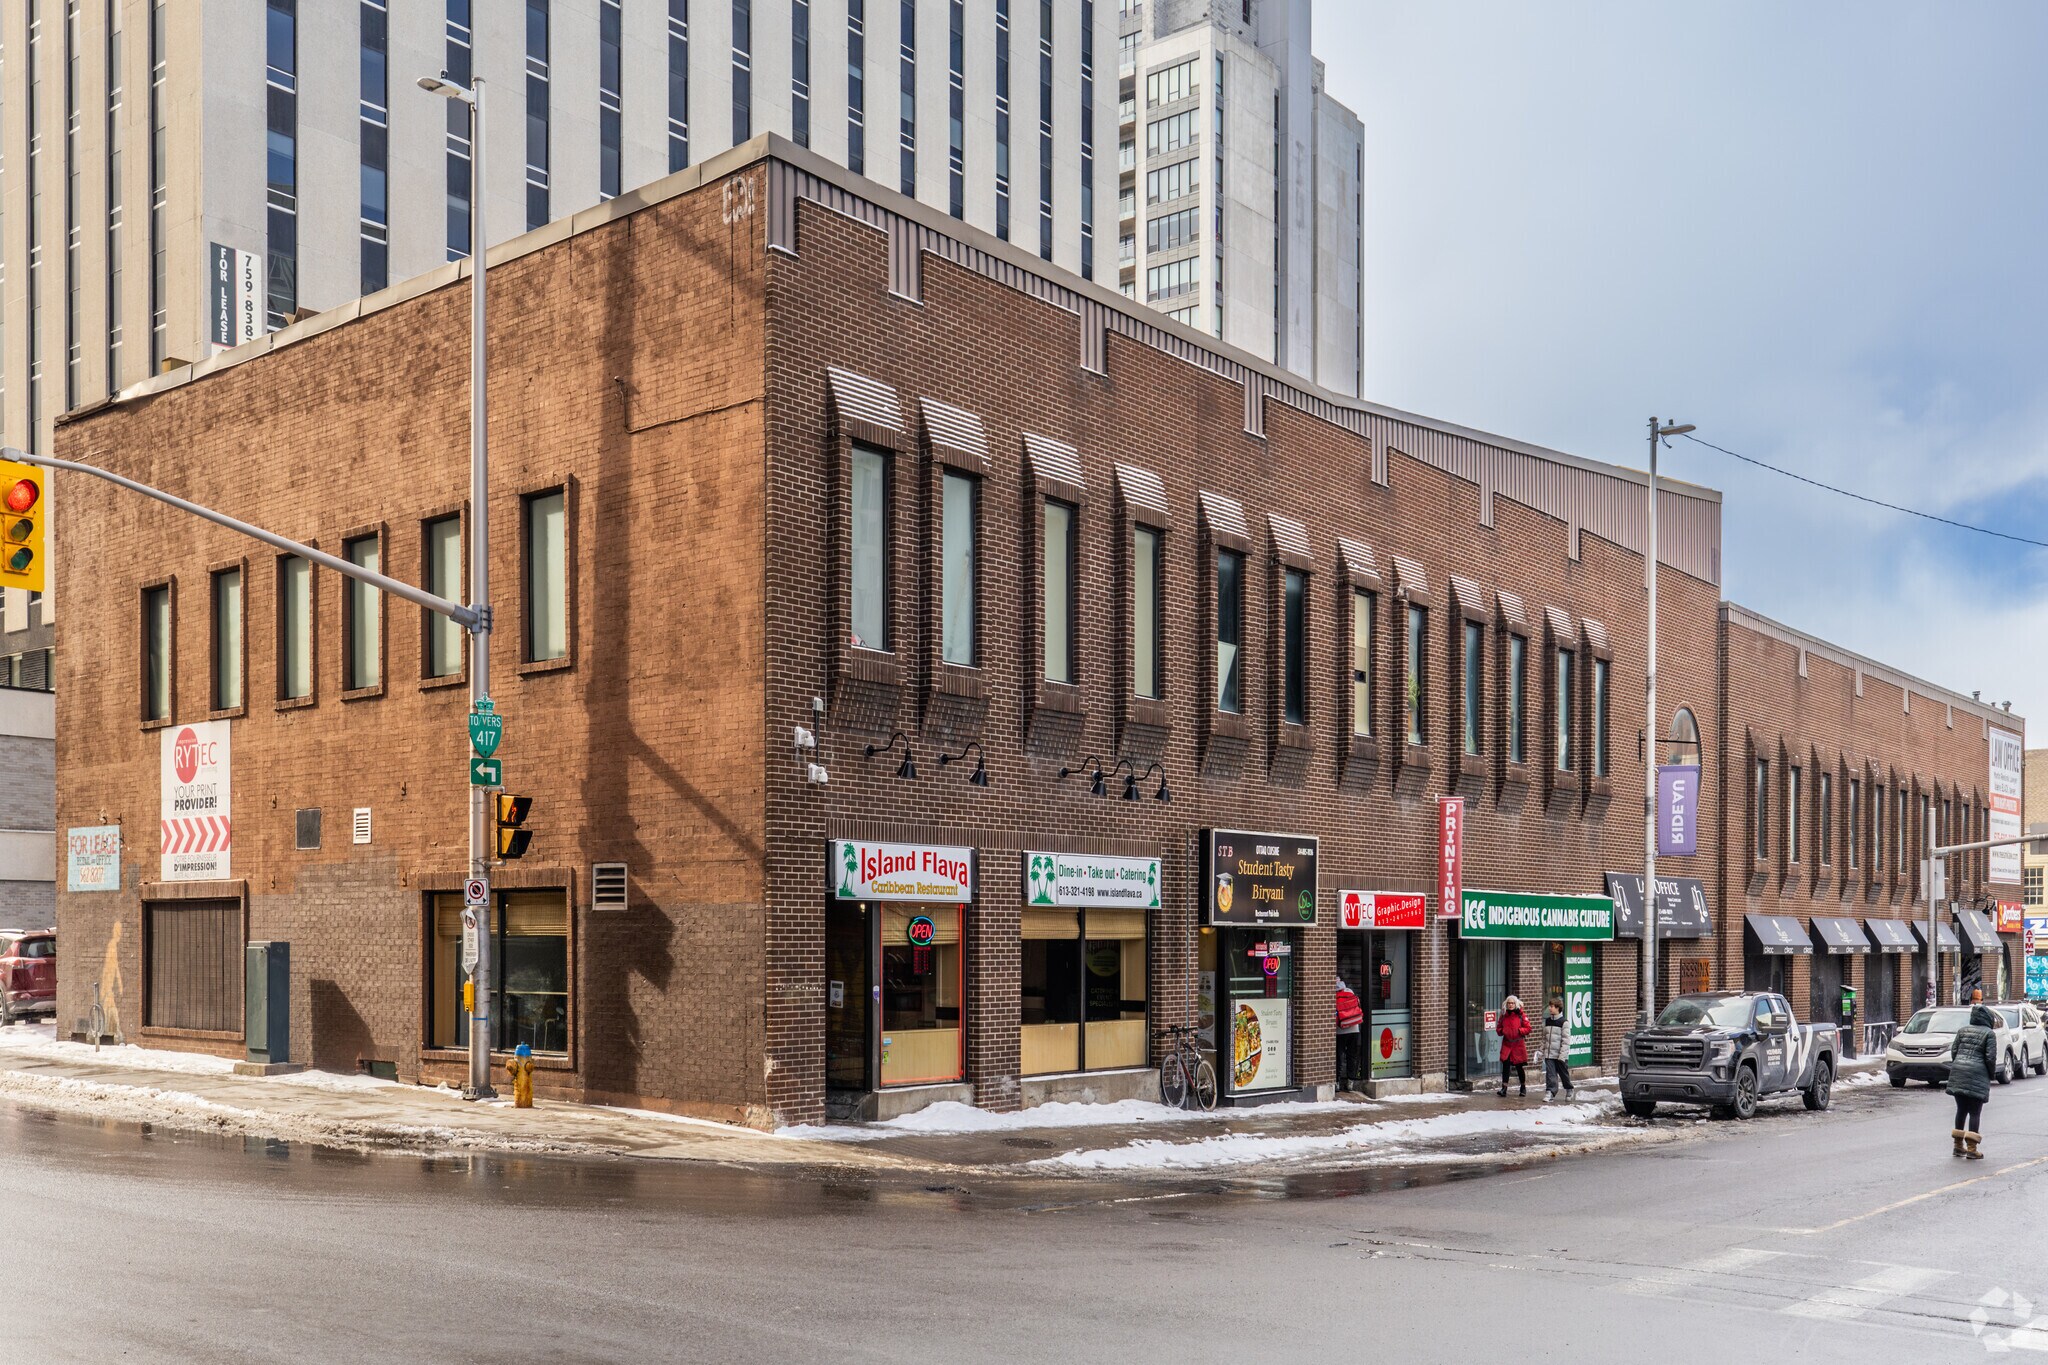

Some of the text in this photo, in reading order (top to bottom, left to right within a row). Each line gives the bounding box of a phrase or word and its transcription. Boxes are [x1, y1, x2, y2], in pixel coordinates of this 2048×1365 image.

[219, 247, 229, 343] FOR LEASE
[476, 730, 496, 746] 417
[175, 741, 217, 769] RYTEC
[174, 782, 217, 799] YOUR PRINT
[174, 795, 218, 811] PROVIDER!
[69, 833, 118, 856] FOR LEASE
[1444, 802, 1457, 913] PRINTING
[174, 862, 217, 872] D'IMPRESSION!
[861, 847, 968, 888] Island Flava
[1059, 864, 1147, 883] Dine-in Take out Catering
[1238, 859, 1295, 880] Student Tasty
[871, 880, 959, 896] Caribbean Restaurant
[1058, 885, 1142, 899] 613-321-4198 www.islandflava.ca
[1252, 884, 1284, 903] Biryani
[1345, 902, 1373, 919] RYTEC
[1488, 905, 1540, 927] INDIGENOUS
[1541, 908, 1579, 928] CANNABIS
[1579, 909, 1611, 928] CULTURE
[910, 924, 933, 938] OPEN
[2025, 929, 2034, 949] ATM
[1265, 957, 1279, 970] OPEN
[1380, 964, 1392, 976] OPEN
